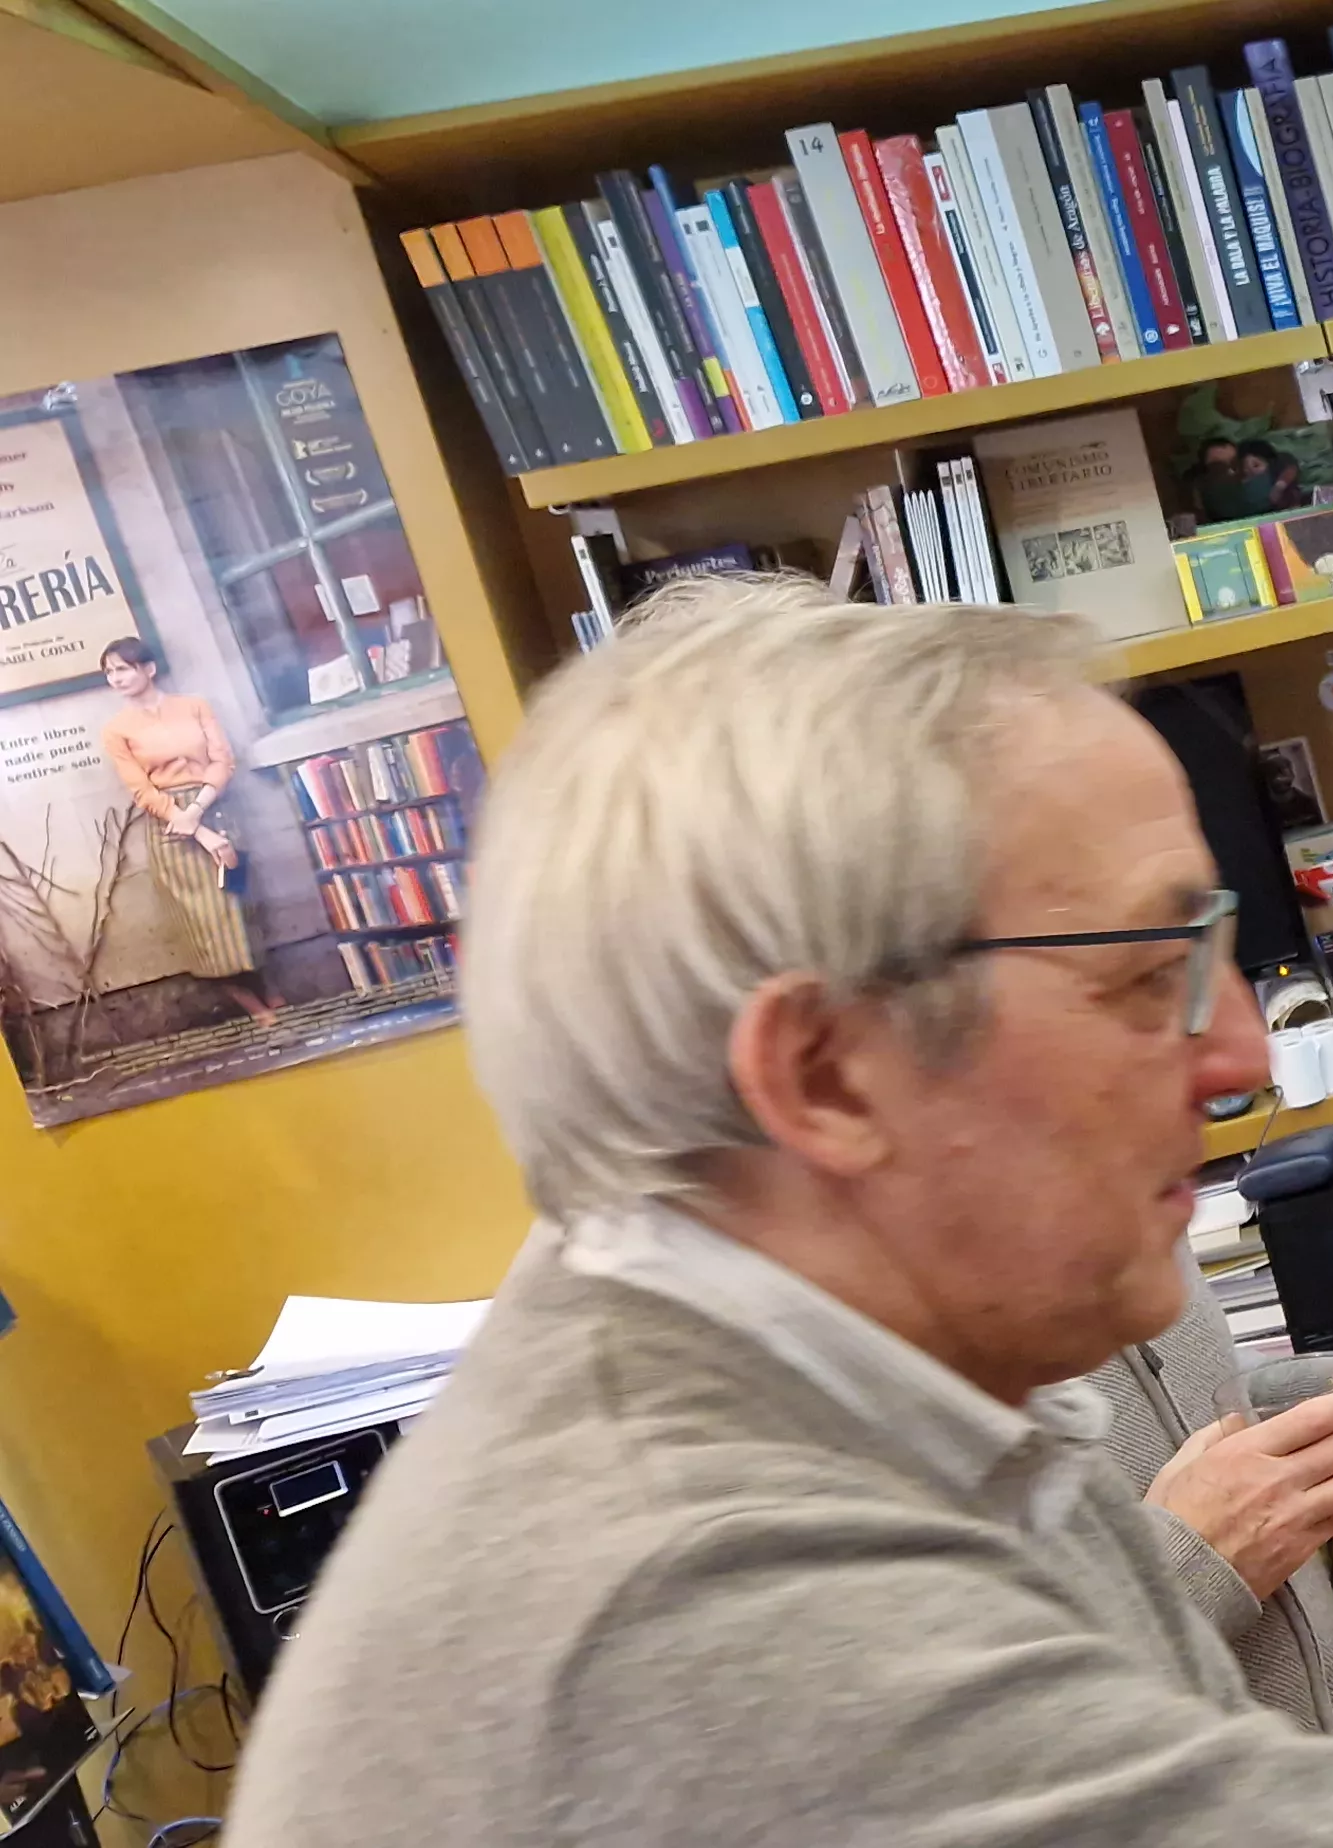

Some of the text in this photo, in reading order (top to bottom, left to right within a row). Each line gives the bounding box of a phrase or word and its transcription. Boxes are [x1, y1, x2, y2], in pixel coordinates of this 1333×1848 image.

[798, 135, 824, 157] 14
[1056, 184, 1088, 251] de Aragón
[1207, 166, 1251, 286] LA BALA Y LA PALABRA
[1260, 249, 1280, 267] EL
[276, 379, 335, 407] GOYA
[1004, 450, 1111, 478] COMUNISMO
[1008, 465, 1113, 493] LIBERTARIO
[40, 639, 86, 660] COIXET
[0, 724, 86, 752] Entre libros
[4, 740, 92, 769] nadie puede
[6, 756, 101, 785] sentirse solo
